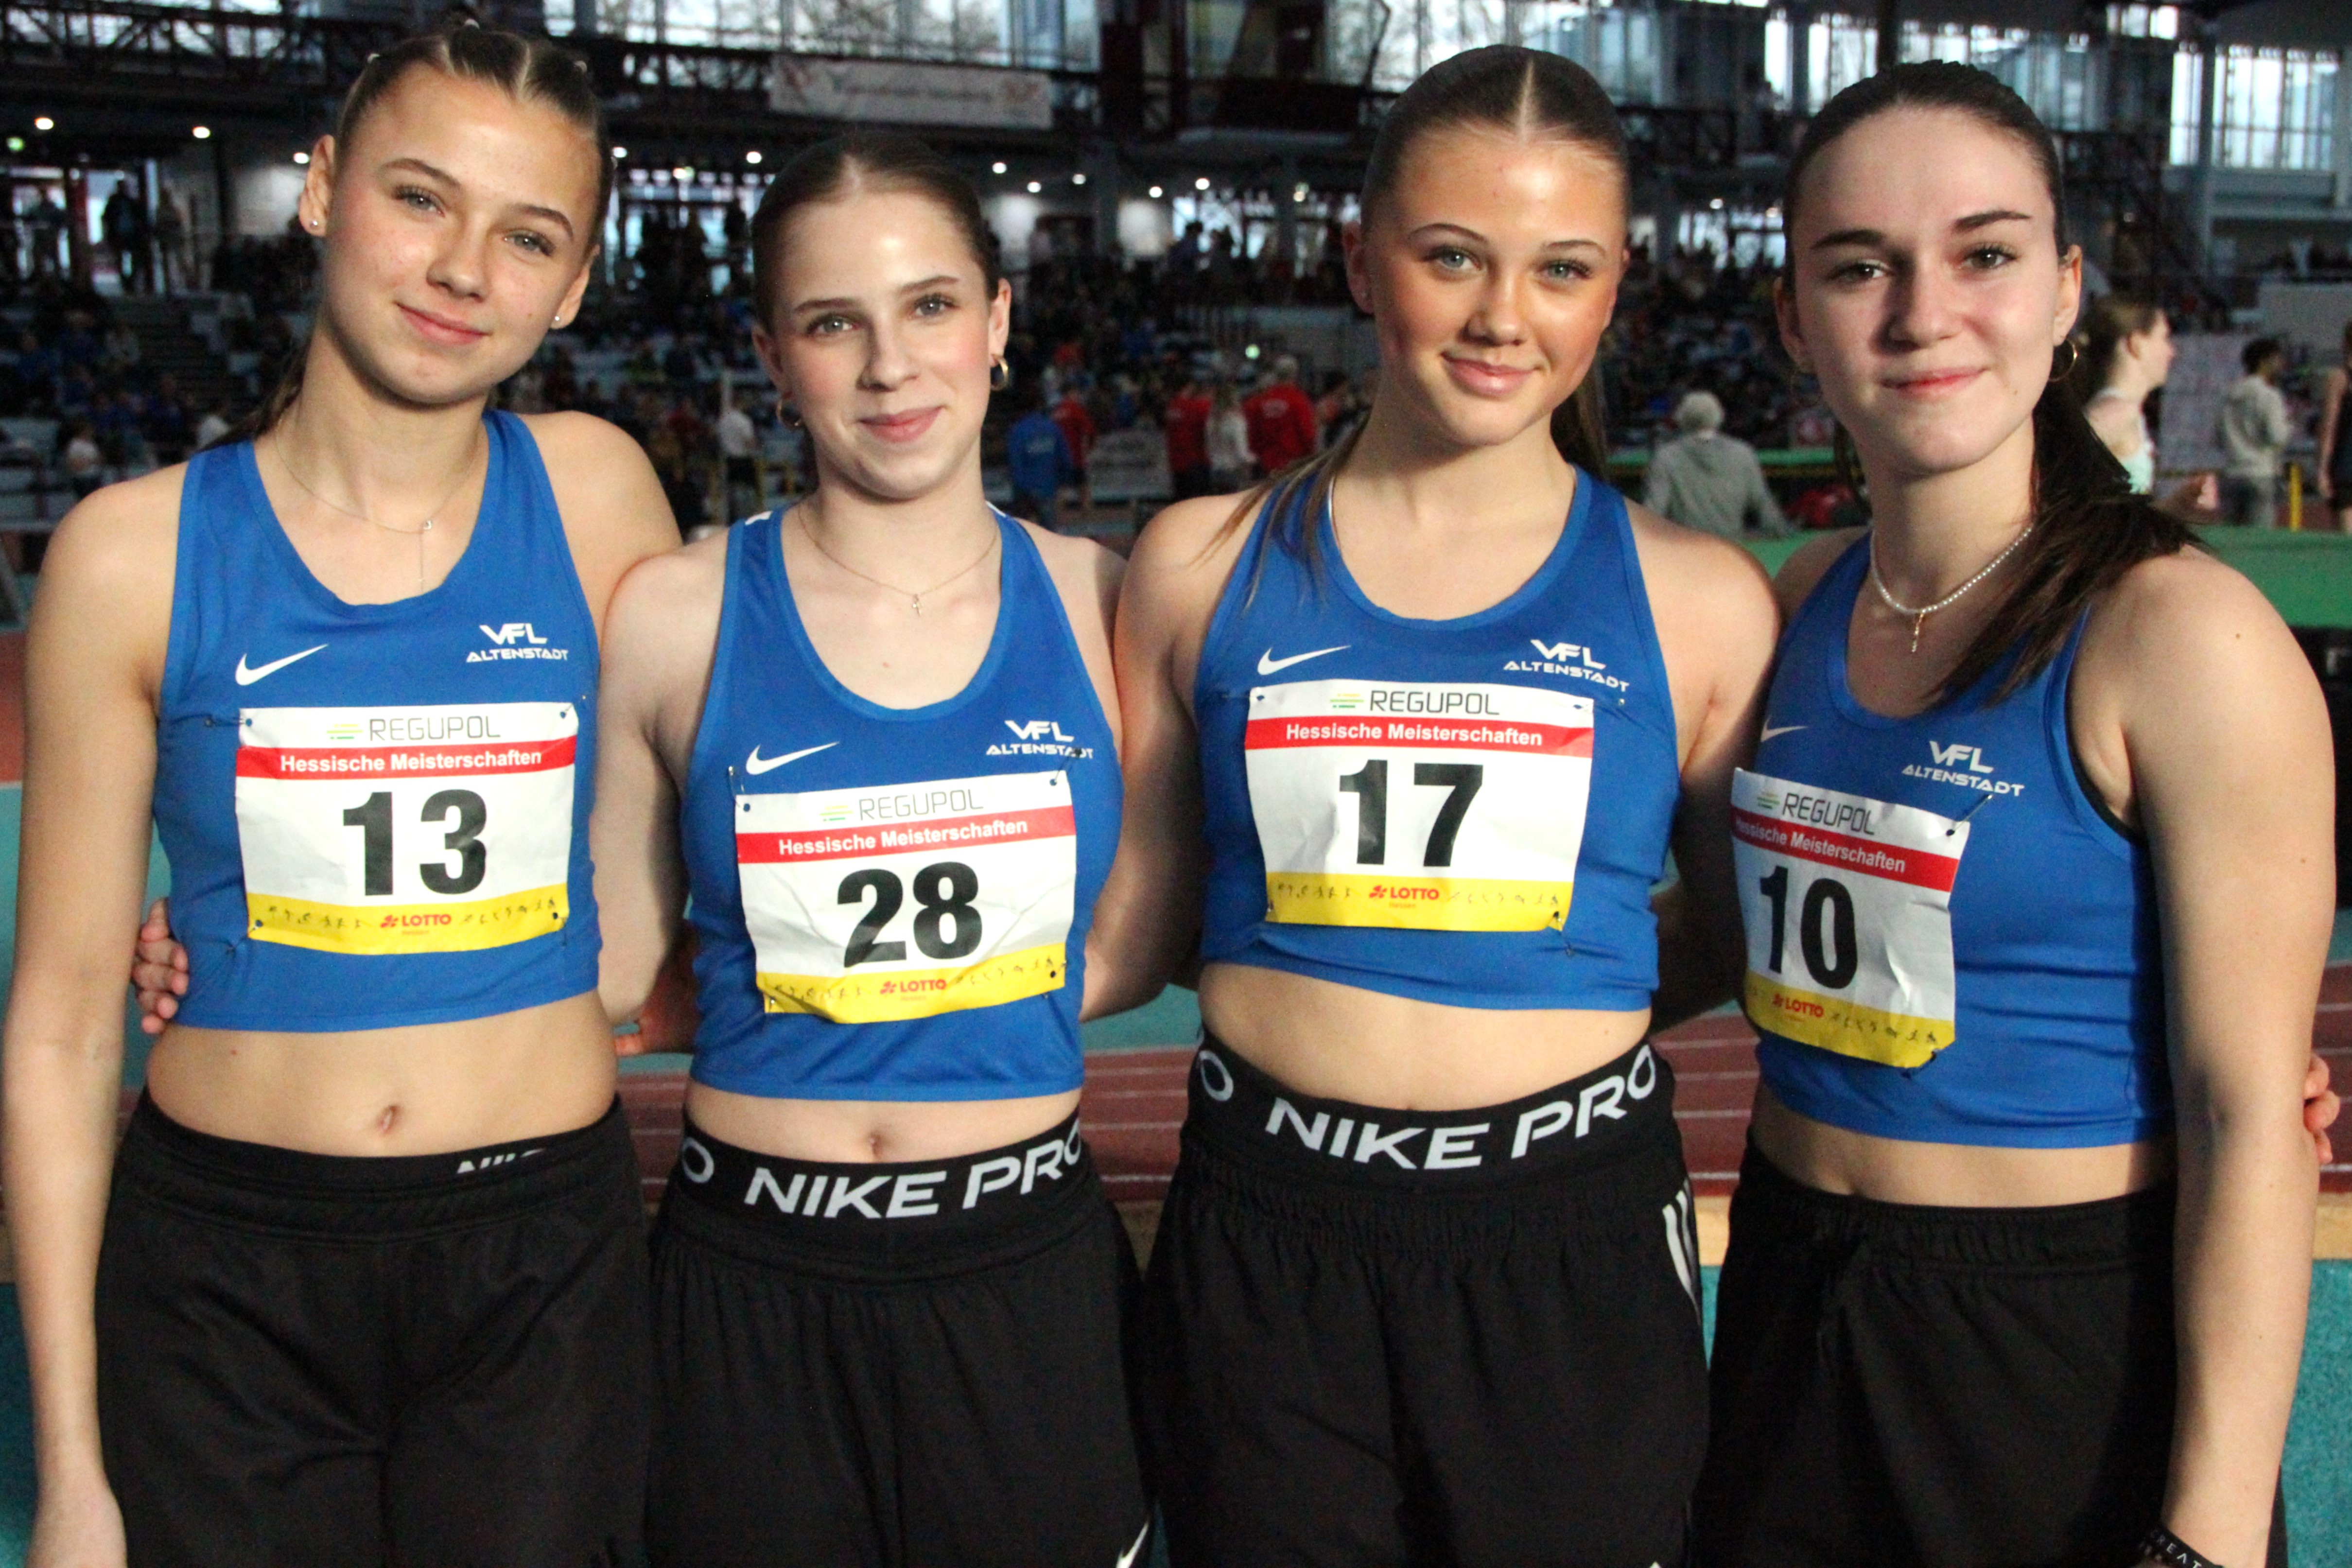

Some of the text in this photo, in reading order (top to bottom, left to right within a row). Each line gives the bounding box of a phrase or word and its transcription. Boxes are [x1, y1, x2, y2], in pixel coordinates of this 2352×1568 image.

[479, 623, 548, 645] VFL
[466, 647, 568, 663] ALTENSTADT
[1530, 639, 1606, 670] VFL
[1503, 661, 1629, 692] ALTENSTADT
[1370, 690, 1500, 716] REGUPOL
[369, 715, 501, 741] REGUPOL
[1005, 720, 1075, 742] VFL
[1287, 723, 1543, 746] Hessische Meisterschaften
[280, 751, 541, 772] Hessische Meisterschaften
[1930, 740, 1994, 773] VFL
[1902, 764, 2025, 797] ALTENSTADT
[859, 789, 983, 821] REGUPOL
[1339, 760, 1483, 868] 17
[1781, 792, 1875, 836] REGUPOL
[343, 788, 488, 897] 13
[779, 819, 1028, 855] Hessische Meisterschaften
[1790, 831, 1906, 873] Meisterschaften
[1391, 887, 1439, 900] LOTTO
[402, 914, 452, 926] LOTTO
[836, 861, 983, 968] 28
[1760, 866, 1858, 990] 10
[900, 979, 946, 993] LOTTO
[1786, 997, 1824, 1018] LOTTO
[1265, 1044, 1655, 1170] NIKE PRO
[744, 1117, 1081, 1219] NIKE PRO
